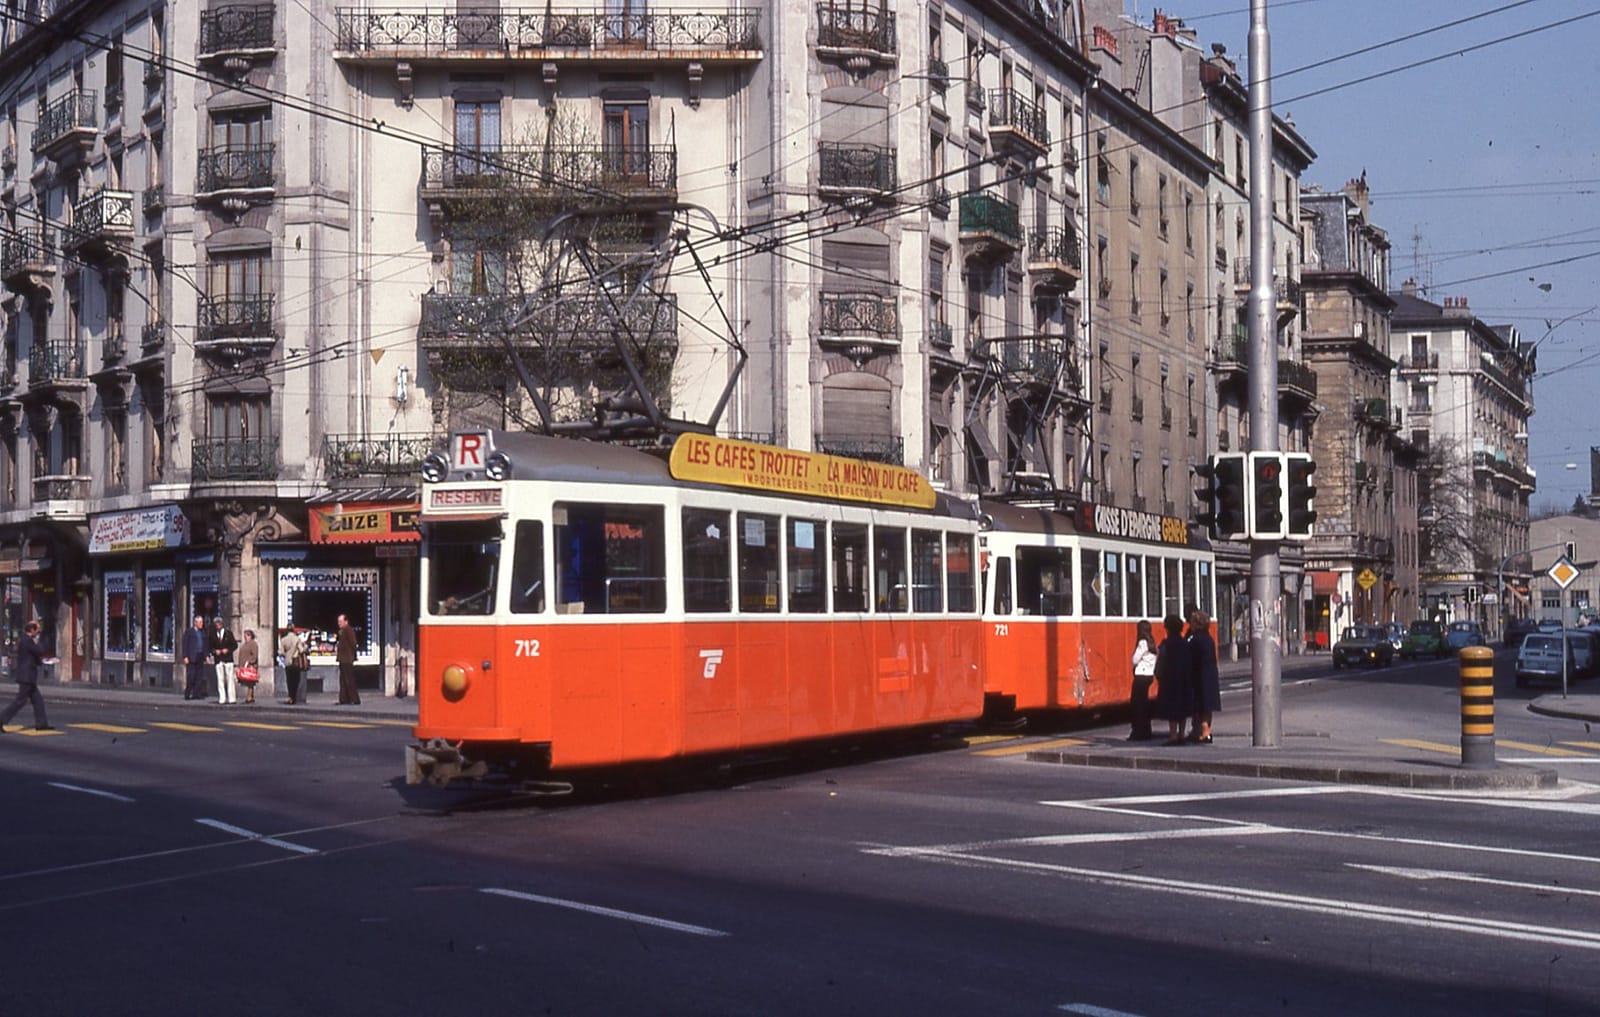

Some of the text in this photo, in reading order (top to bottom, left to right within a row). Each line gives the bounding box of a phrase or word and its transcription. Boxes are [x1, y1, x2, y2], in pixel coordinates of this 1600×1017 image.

[460, 435, 481, 465] R
[687, 440, 711, 465] LES
[760, 450, 811, 478] TROTTET
[827, 461, 840, 482] LA
[843, 463, 880, 489] MAISON
[882, 469, 896, 490] DU
[435, 491, 501, 504] RESERVE
[1095, 504, 1120, 536] CAISSE
[280, 574, 341, 582] AMERICAN
[994, 624, 1009, 636] 721
[515, 640, 540, 656] 712
